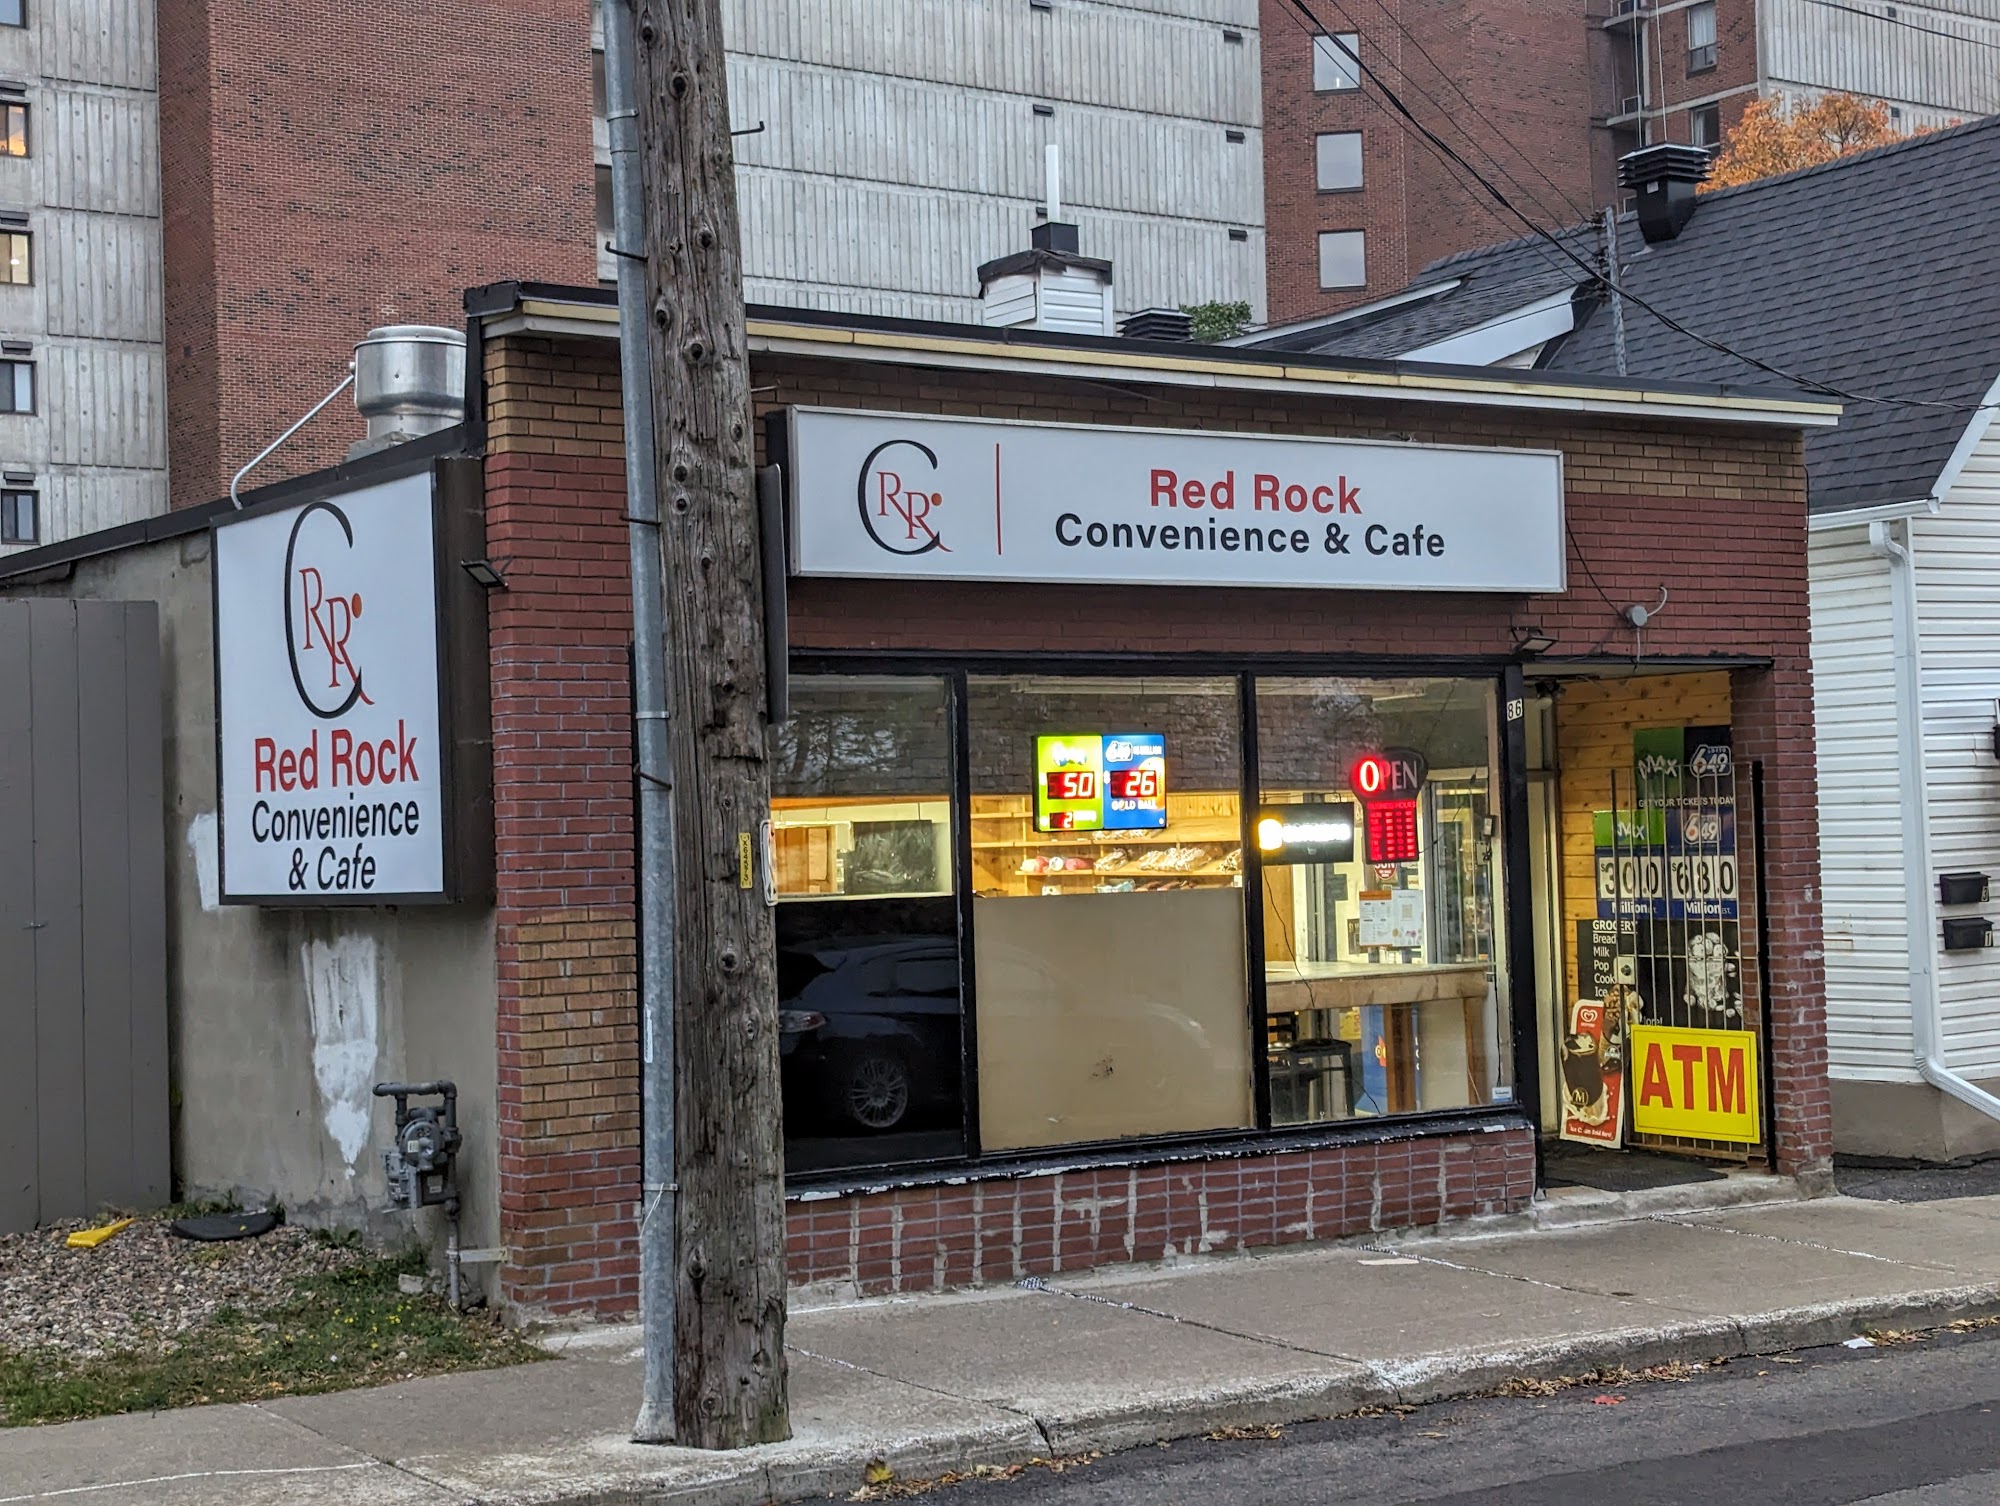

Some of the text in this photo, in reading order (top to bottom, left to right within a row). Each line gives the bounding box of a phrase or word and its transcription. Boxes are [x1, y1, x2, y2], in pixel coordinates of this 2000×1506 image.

[1150, 469, 1363, 515] Red Rock
[1055, 512, 1446, 558] Convenience & Cafe
[1507, 700, 1522, 719] 86
[254, 719, 420, 793] Red Rock
[1064, 772, 1094, 797] 50
[1125, 771, 1155, 796] 26
[1360, 761, 1418, 792] OPEN
[1638, 799, 1652, 808] GT
[1676, 796, 1708, 806] TCKES
[252, 792, 420, 843] Convenience
[288, 842, 376, 891] & Cafe
[1982, 887, 1989, 901] 3
[1686, 901, 1720, 914] Milion
[1593, 933, 1617, 944] Bread
[1593, 946, 1610, 957] Milk
[1594, 959, 1610, 973] Pop
[1594, 973, 1616, 984] Cook
[1595, 986, 1608, 997] Ice
[1640, 1043, 1747, 1115] ATM
